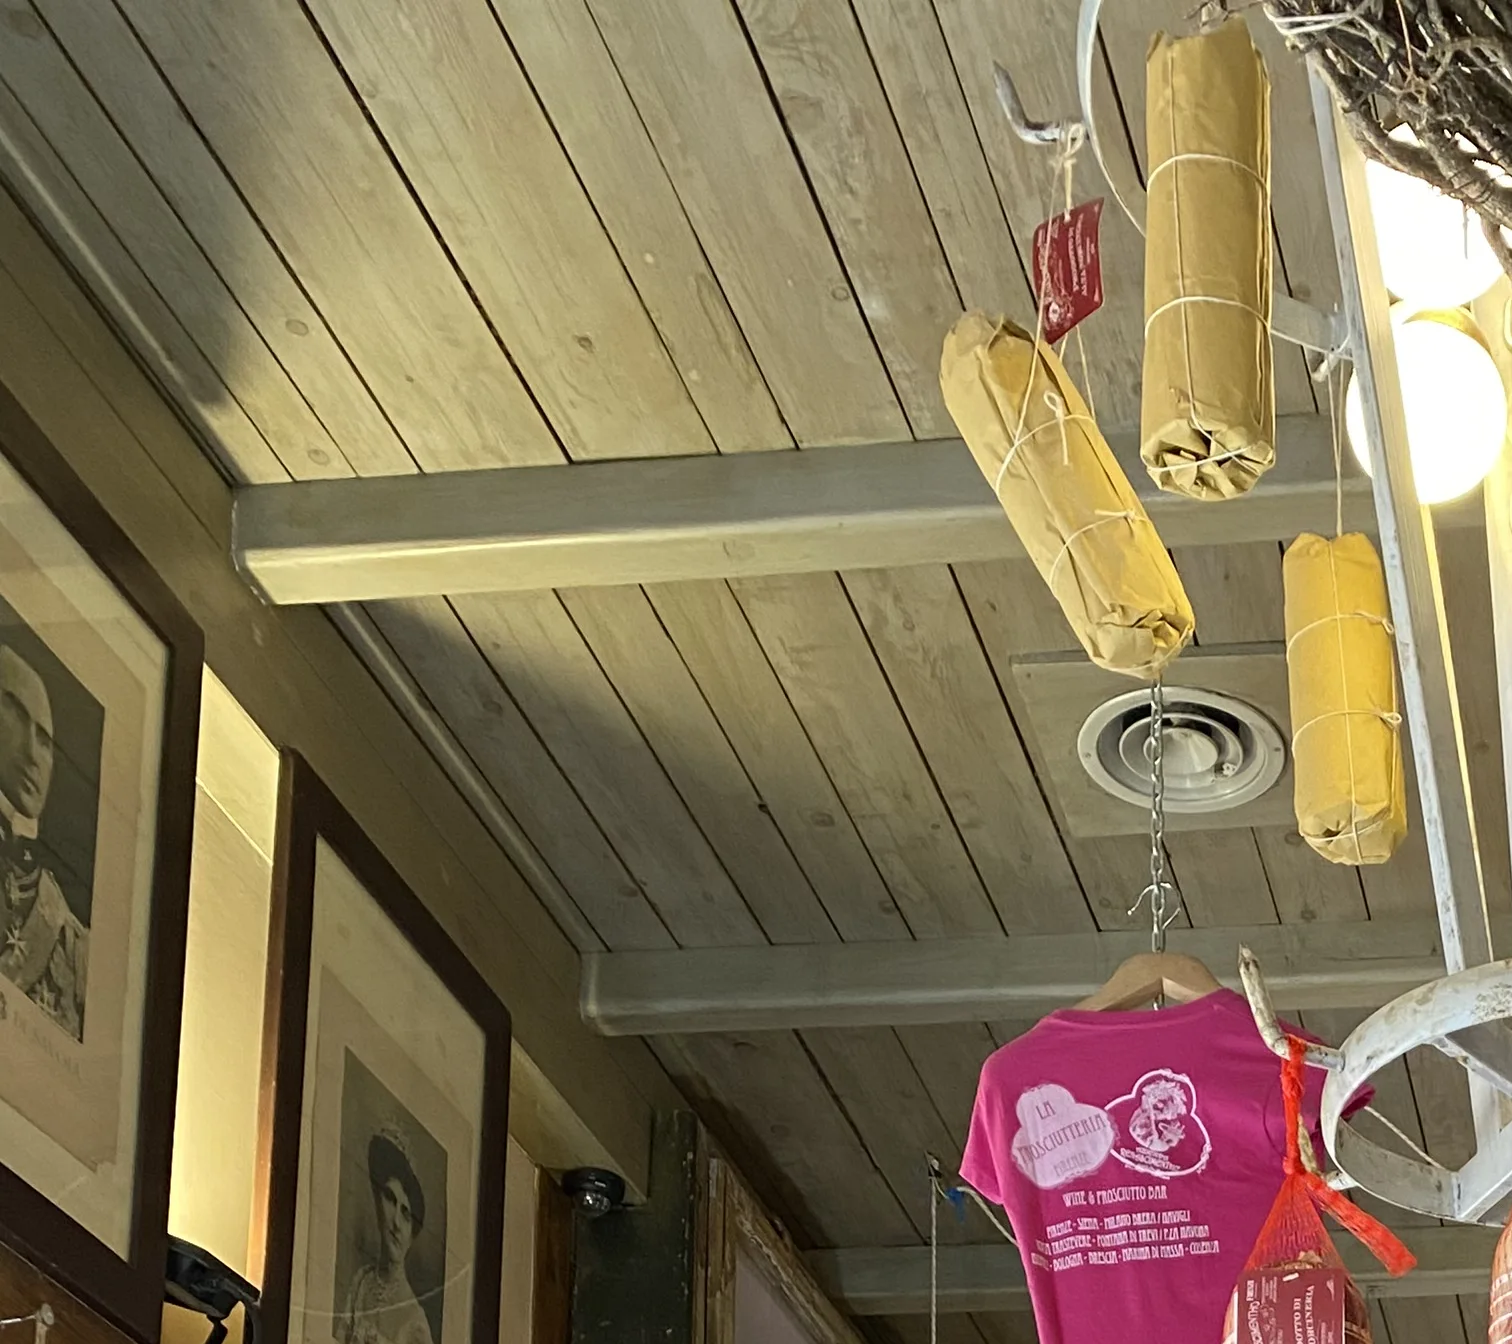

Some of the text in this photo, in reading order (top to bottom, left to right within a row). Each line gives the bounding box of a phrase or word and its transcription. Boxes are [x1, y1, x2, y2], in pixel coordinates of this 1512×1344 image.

[1036, 1101, 1056, 1120] LA
[1097, 1186, 1146, 1204] PROSCIUTTO
[1148, 1186, 1167, 1200] BAR
